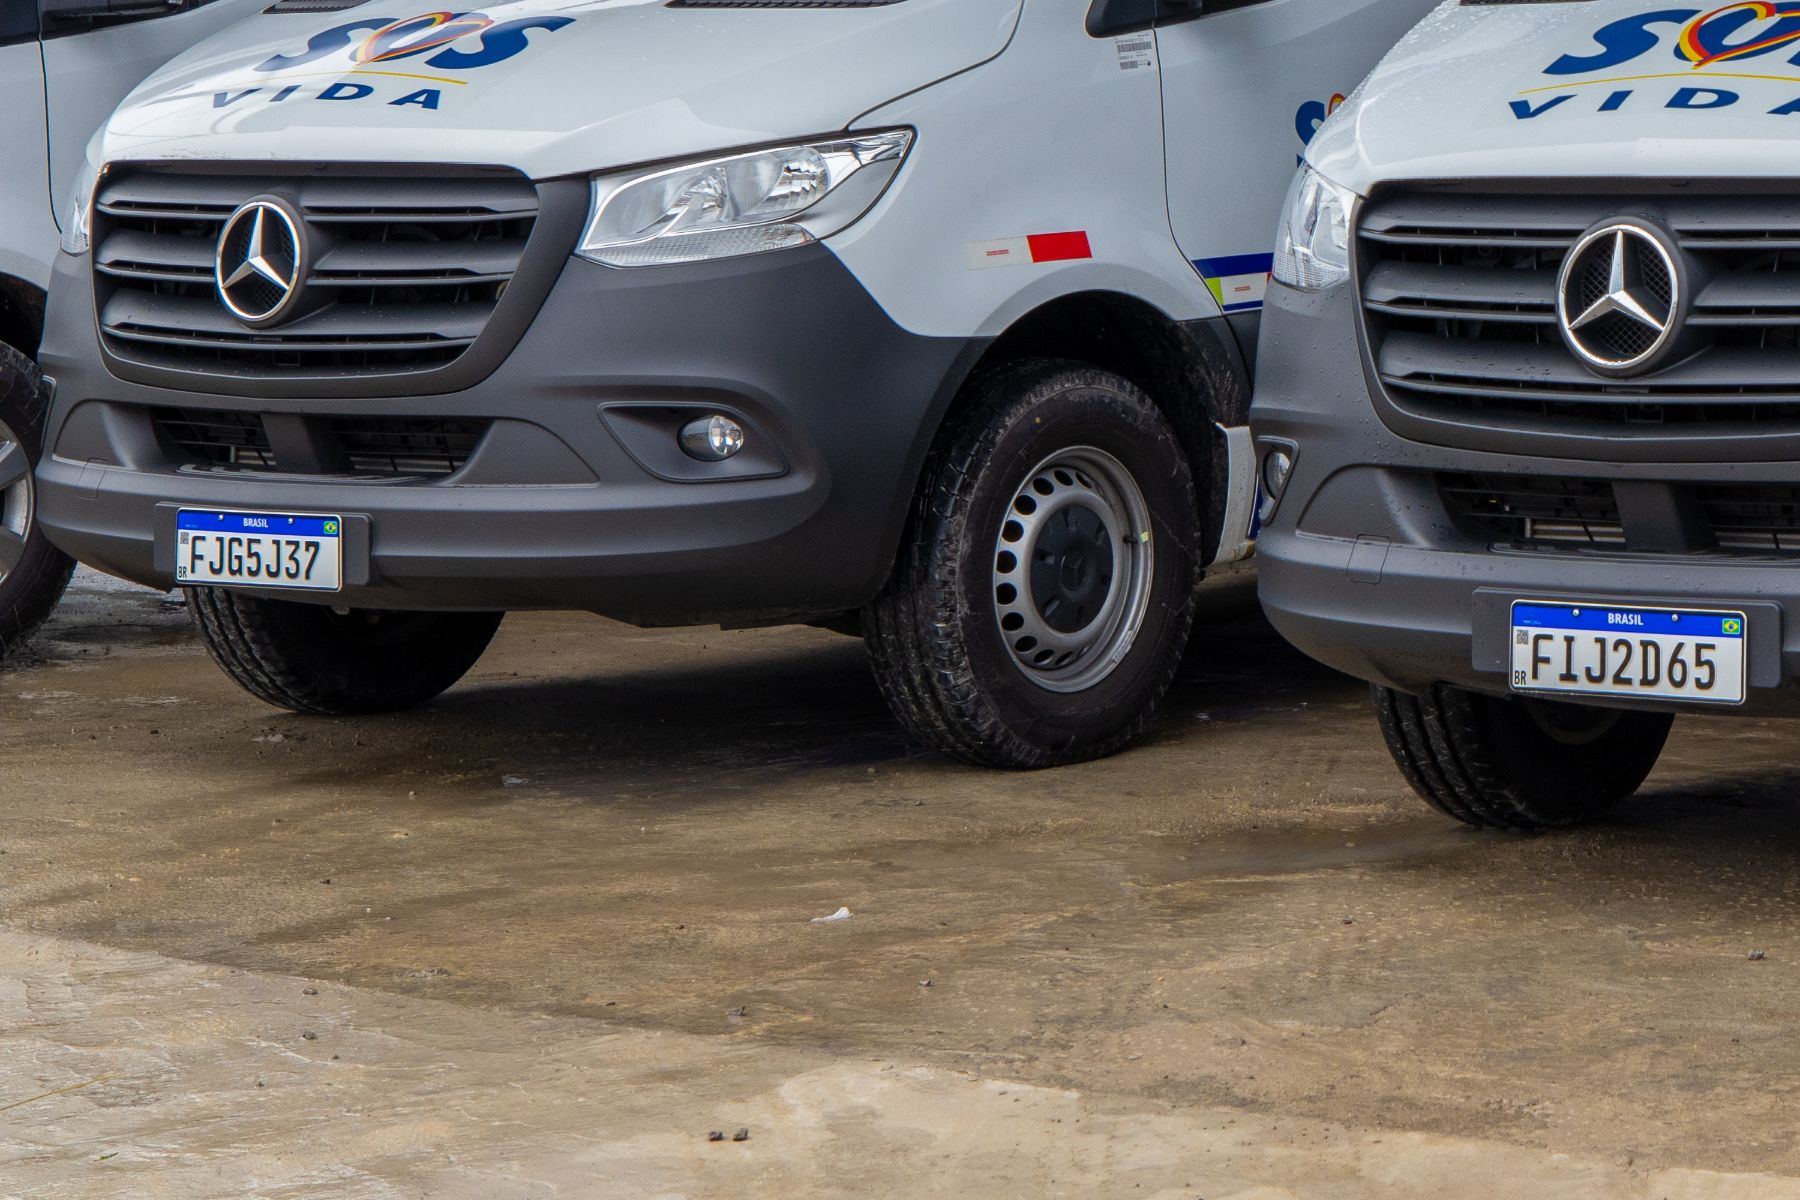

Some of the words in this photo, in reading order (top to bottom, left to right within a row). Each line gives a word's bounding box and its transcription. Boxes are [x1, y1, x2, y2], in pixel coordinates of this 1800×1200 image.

[253, 11, 577, 72] SOS
[212, 81, 441, 110] VIDA
[243, 517, 269, 529] BRASIL
[189, 535, 321, 581] FJG5J37
[178, 565, 188, 579] BR
[1607, 612, 1645, 626] BRASIL
[1531, 633, 1716, 691] FIJ2D65
[1513, 670, 1527, 686] BR
